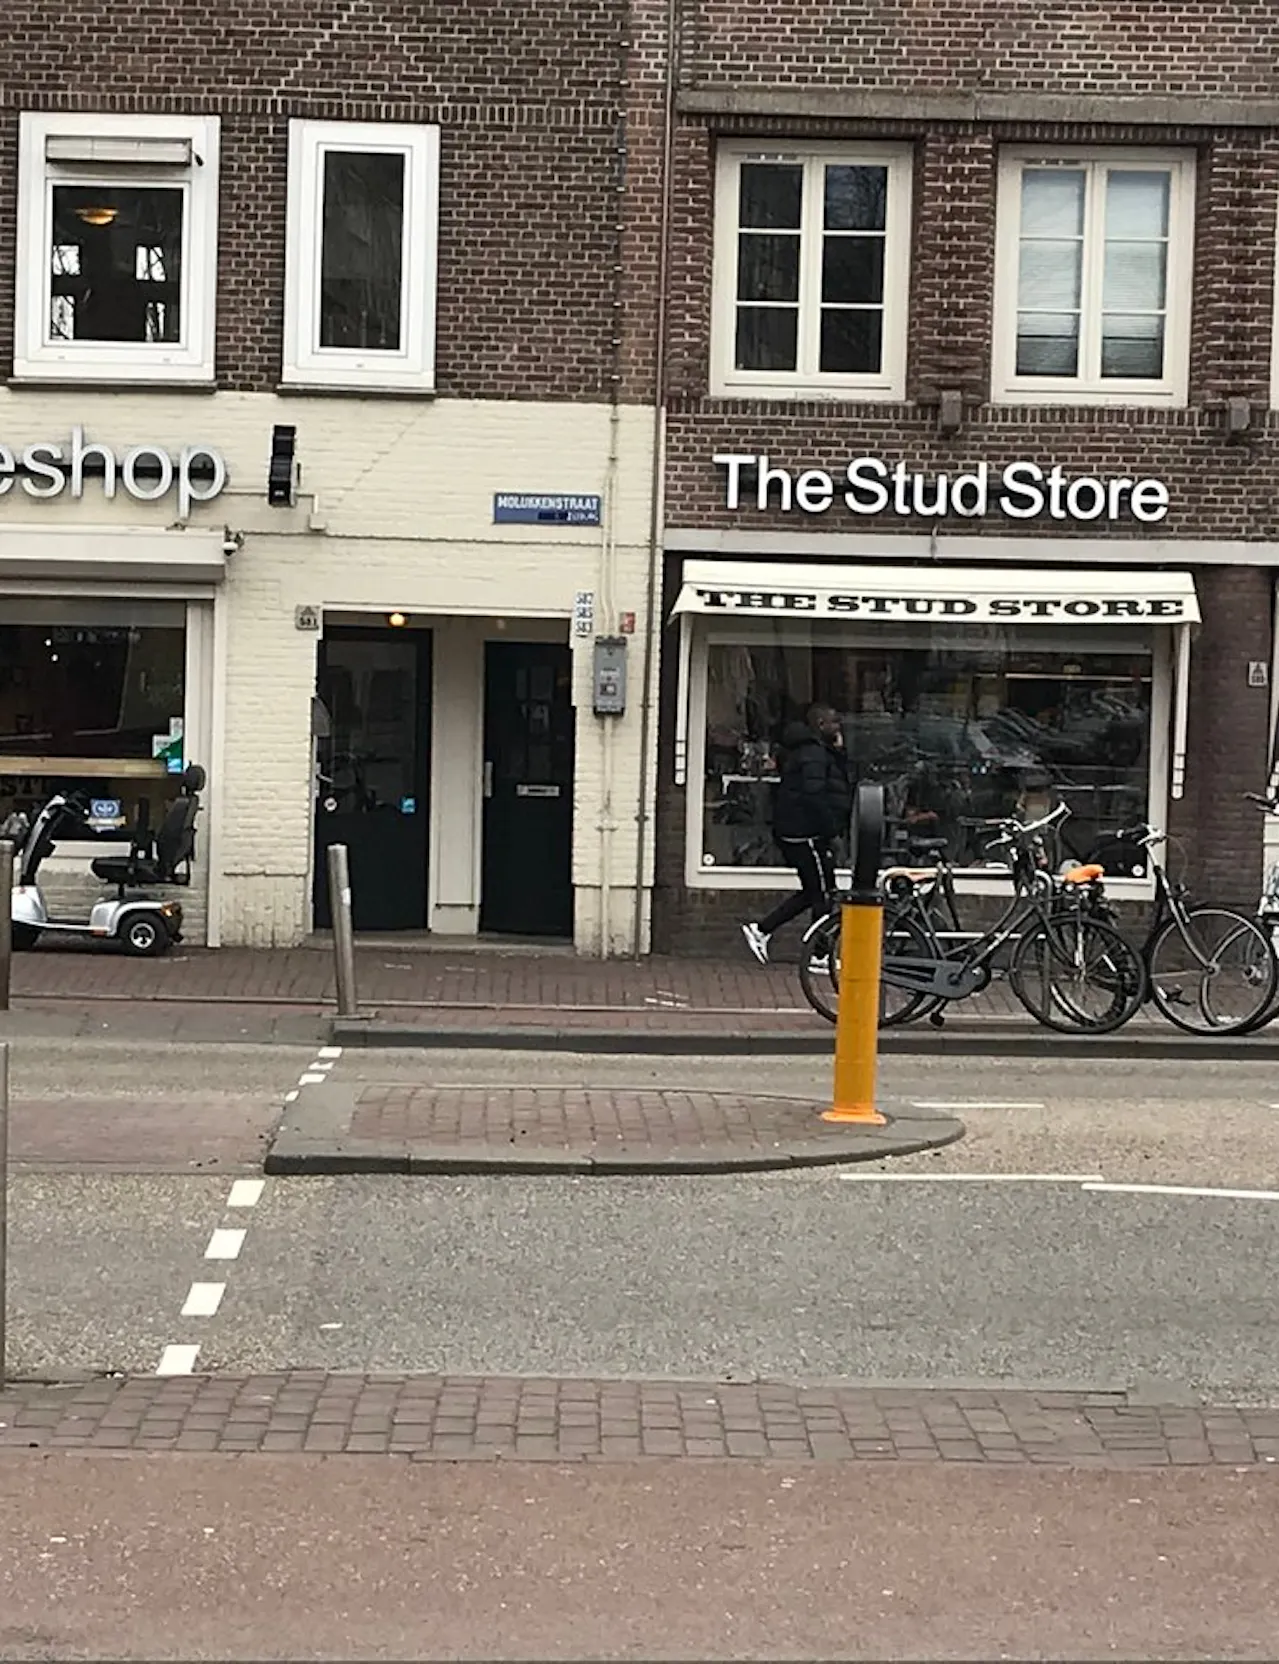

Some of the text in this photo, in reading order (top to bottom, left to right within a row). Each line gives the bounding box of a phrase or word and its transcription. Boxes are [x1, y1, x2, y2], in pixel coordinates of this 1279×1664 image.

[712, 454, 1170, 522] The Stud Store
[497, 495, 599, 510] MOLUKKENSTRAAT
[697, 589, 1183, 616] THE STUD STORE
